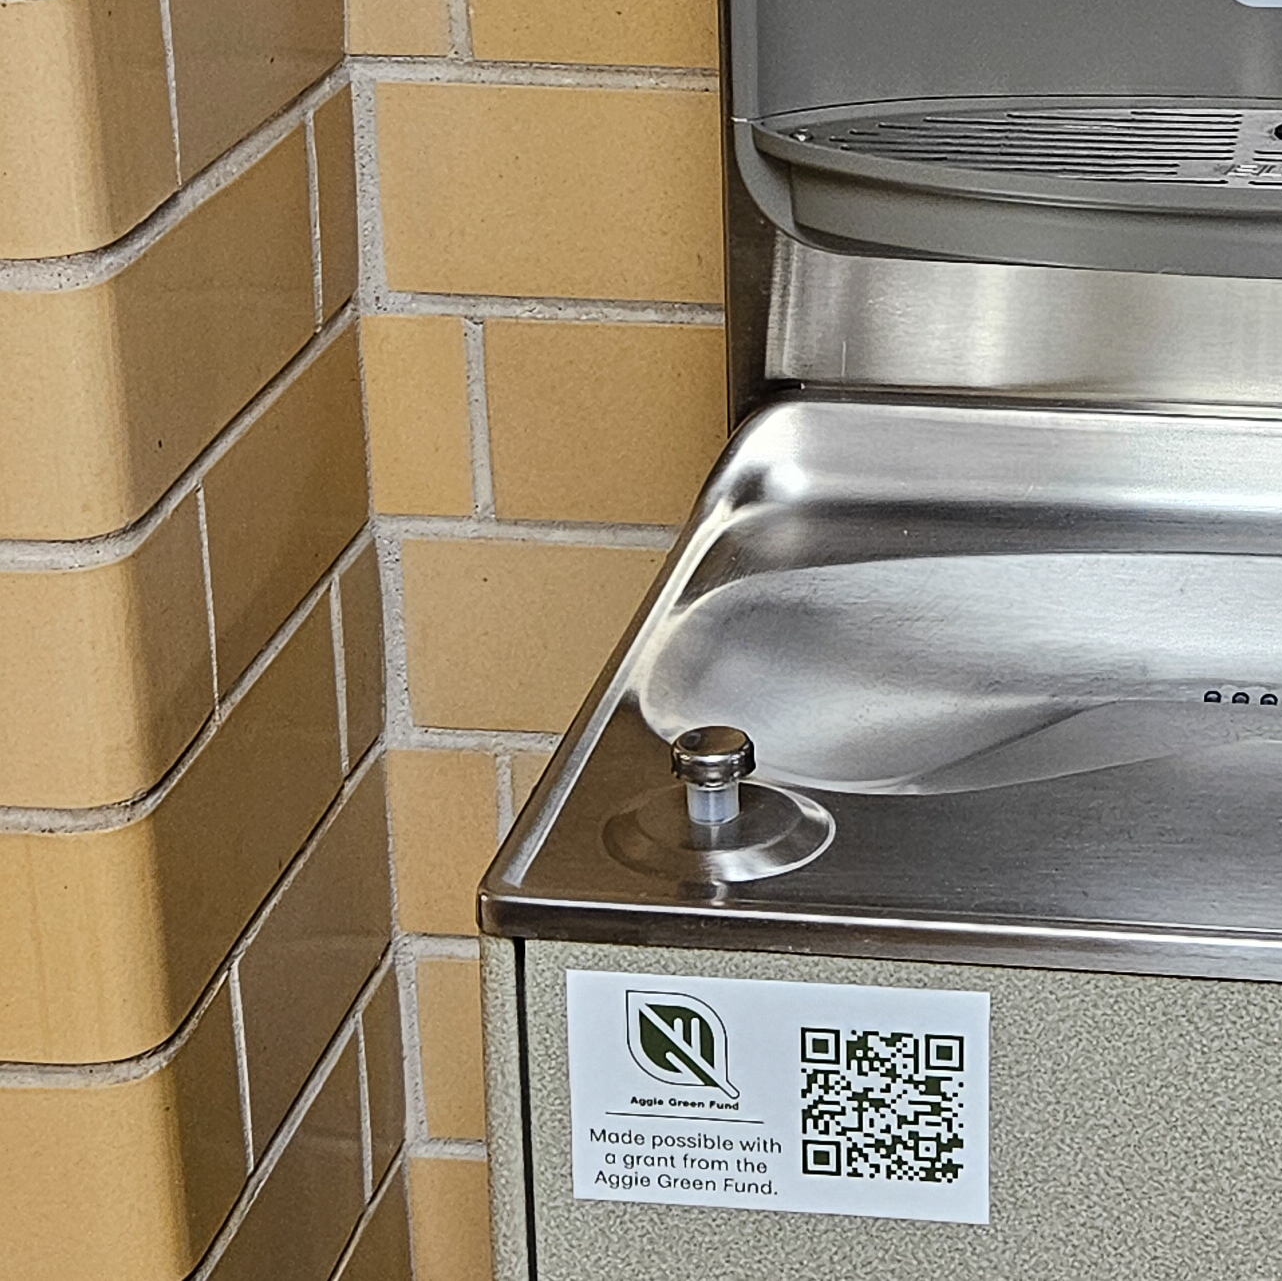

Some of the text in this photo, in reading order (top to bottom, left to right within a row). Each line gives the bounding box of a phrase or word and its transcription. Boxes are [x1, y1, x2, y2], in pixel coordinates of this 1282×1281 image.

[630, 1096, 740, 1111] Aggie Green Fund
[589, 1128, 782, 1154] Made possible with
[604, 1152, 768, 1174] a grant from the
[594, 1170, 779, 1196] Aggie Green Fund.
